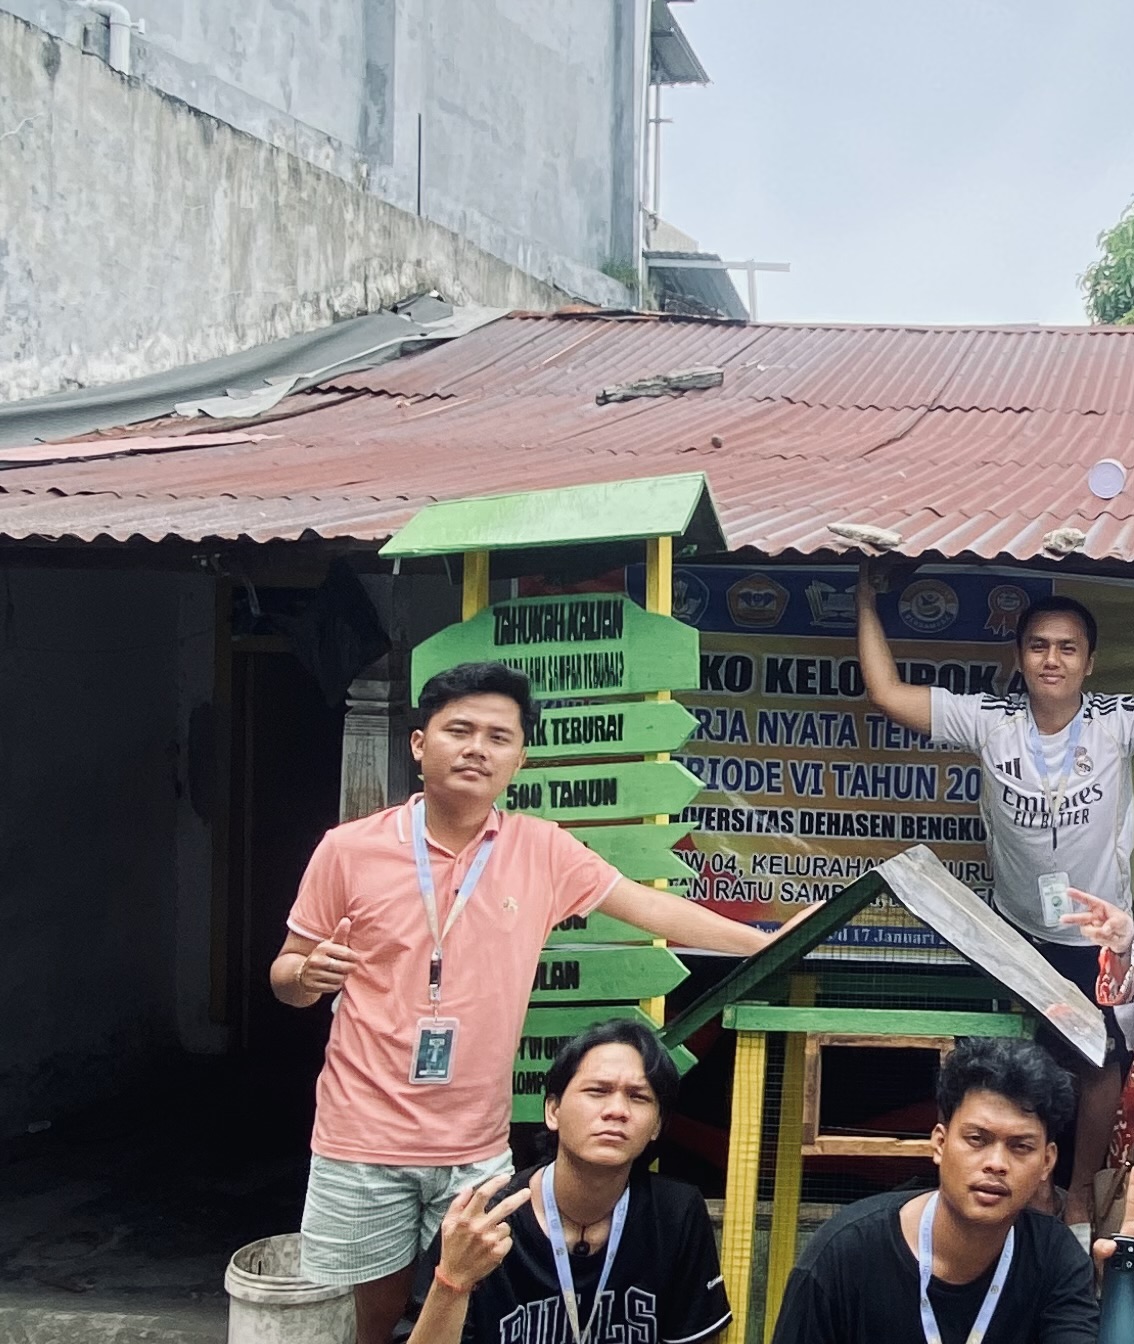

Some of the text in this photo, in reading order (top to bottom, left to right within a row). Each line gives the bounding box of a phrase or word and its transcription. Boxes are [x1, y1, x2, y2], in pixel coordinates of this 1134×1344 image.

[493, 599, 624, 646] TAHUKAH KALIAN
[700, 655, 752, 692] KO
[765, 657, 998, 696] KELOPOK
[688, 708, 749, 743] RJA
[759, 711, 857, 747] NYATA
[506, 777, 617, 810] 500 TAHUN
[791, 760, 824, 795] VI
[832, 763, 936, 801] TAHUN
[946, 767, 980, 801] 20
[1003, 783, 1103, 813] Emiates
[800, 809, 896, 838] DEHASEN
[901, 815, 988, 842] BENGKU
[1014, 808, 1090, 829] FLY BTTER
[752, 854, 885, 878] KELURAHA
[715, 879, 773, 901] RATU
[532, 960, 579, 992] LAN
